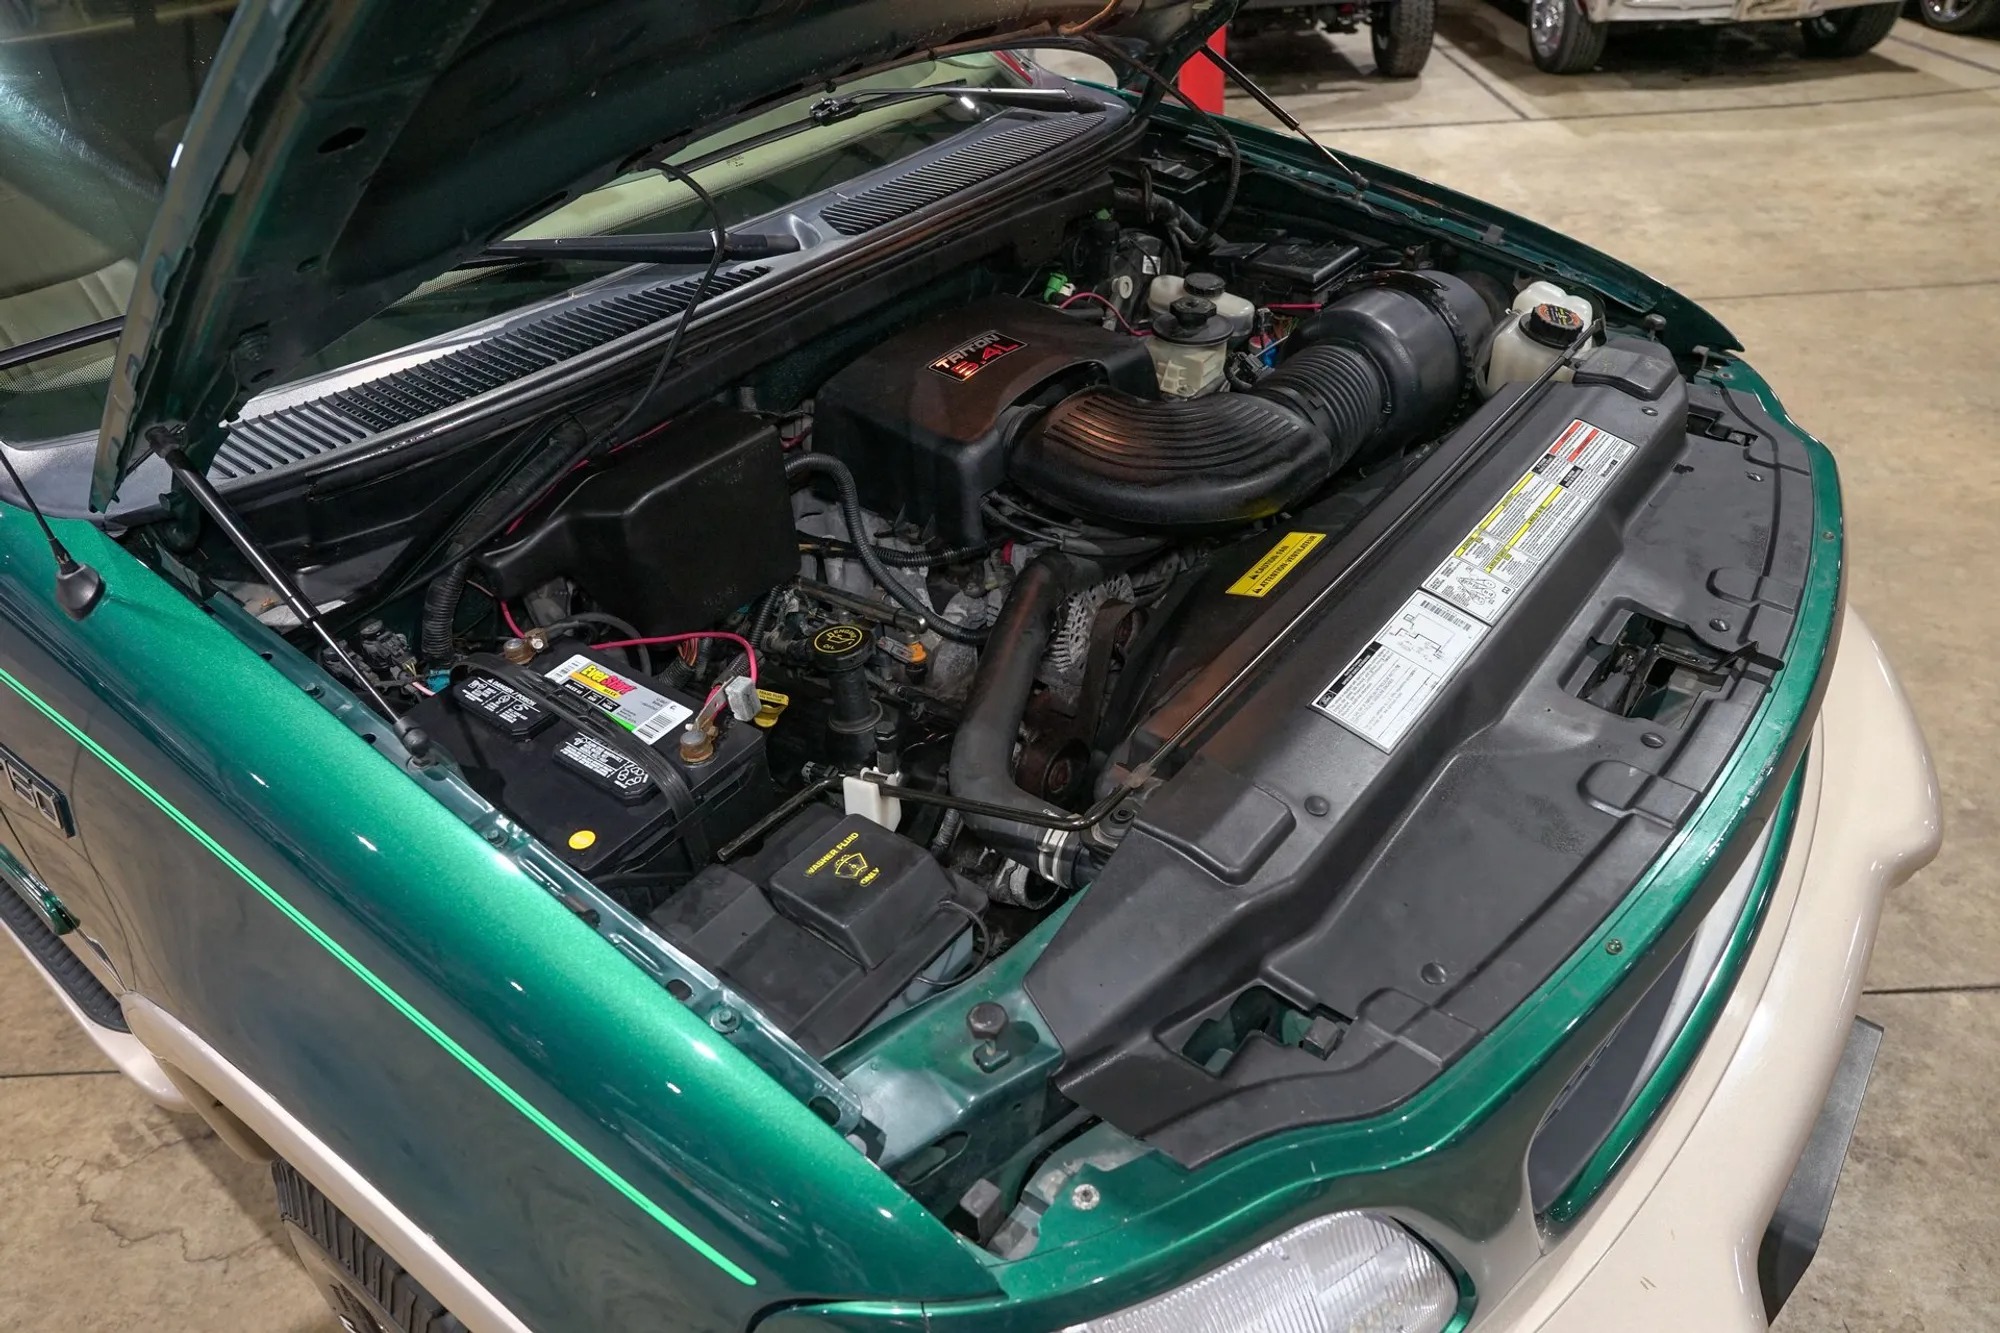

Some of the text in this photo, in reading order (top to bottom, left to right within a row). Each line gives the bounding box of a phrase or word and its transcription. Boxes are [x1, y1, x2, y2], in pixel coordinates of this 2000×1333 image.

[936, 334, 1000, 369] TRITON
[951, 343, 1019, 376] 5.4L
[833, 629, 857, 639] ENGINE
[580, 664, 637, 695] EverStart
[836, 832, 859, 850] FLUID
[860, 867, 880, 886] ONLY
